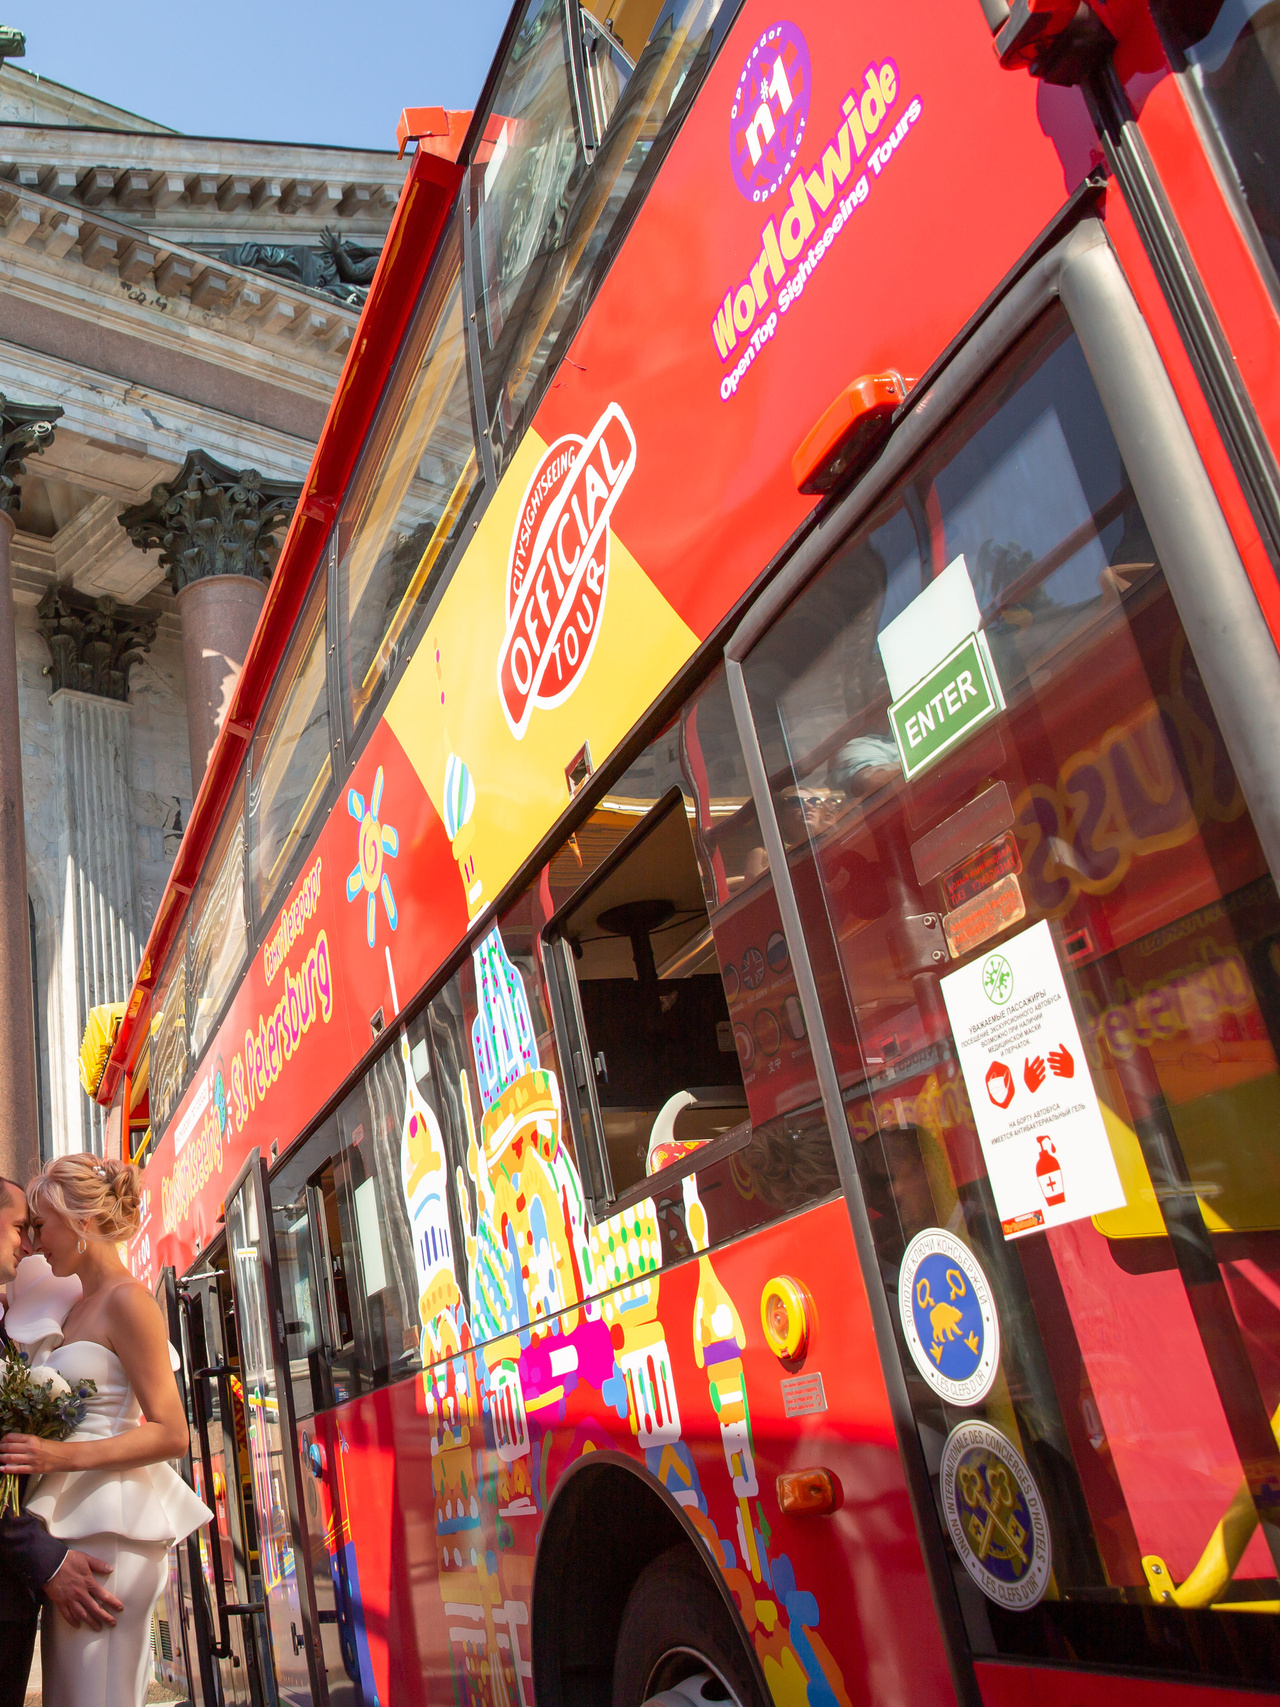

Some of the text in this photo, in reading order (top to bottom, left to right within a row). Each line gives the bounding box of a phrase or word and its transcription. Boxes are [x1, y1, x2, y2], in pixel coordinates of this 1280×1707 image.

[730, 26, 782, 119] Operador
[753, 117, 806, 202] Operator
[711, 62, 898, 360] Worldwide
[777, 174, 869, 313] Sightseeing
[867, 99, 922, 175] Tours
[510, 437, 624, 695] OFFICIAL
[550, 557, 605, 681] TOUR
[903, 668, 980, 750] ENTER
[245, 929, 333, 1111] Petersburg
[960, 993, 1062, 1049] ПОСЕЩЕНИЕ ЭКСКУРСИОННОГО АВТОБУСА
[968, 989, 1047, 1034] УВАЖАЕМЫЕ ПАССАЖИРЫ
[980, 1012, 1044, 1048] ВОЗМОЖНО ПРИ НАЛИЧИИ
[987, 1022, 1042, 1054] МЕДИЦИНСКОЙ МАСКИ
[1004, 1038, 1031, 1056] ПЕРЧАТОК
[991, 1103, 1086, 1145] ИМЕЕТСЯ АНТИБАКТЕРИАЛЬНЫЙ ГЕЛЬ
[1008, 1103, 1061, 1129] НА БОРТУ АВТОБУСА
[903, 1268, 915, 1328] ЗОЛОТЫЕ
[909, 1237, 935, 1267] КЛЮЧИ
[935, 1369, 986, 1398] LES CLEFS D'OR
[968, 1429, 984, 1446] DES
[985, 1431, 1033, 1496] CONCIERGES
[943, 1433, 970, 1516] INTERNATIONALE
[949, 1517, 970, 1560] UNION
[997, 1582, 1021, 1603] CLEFS
